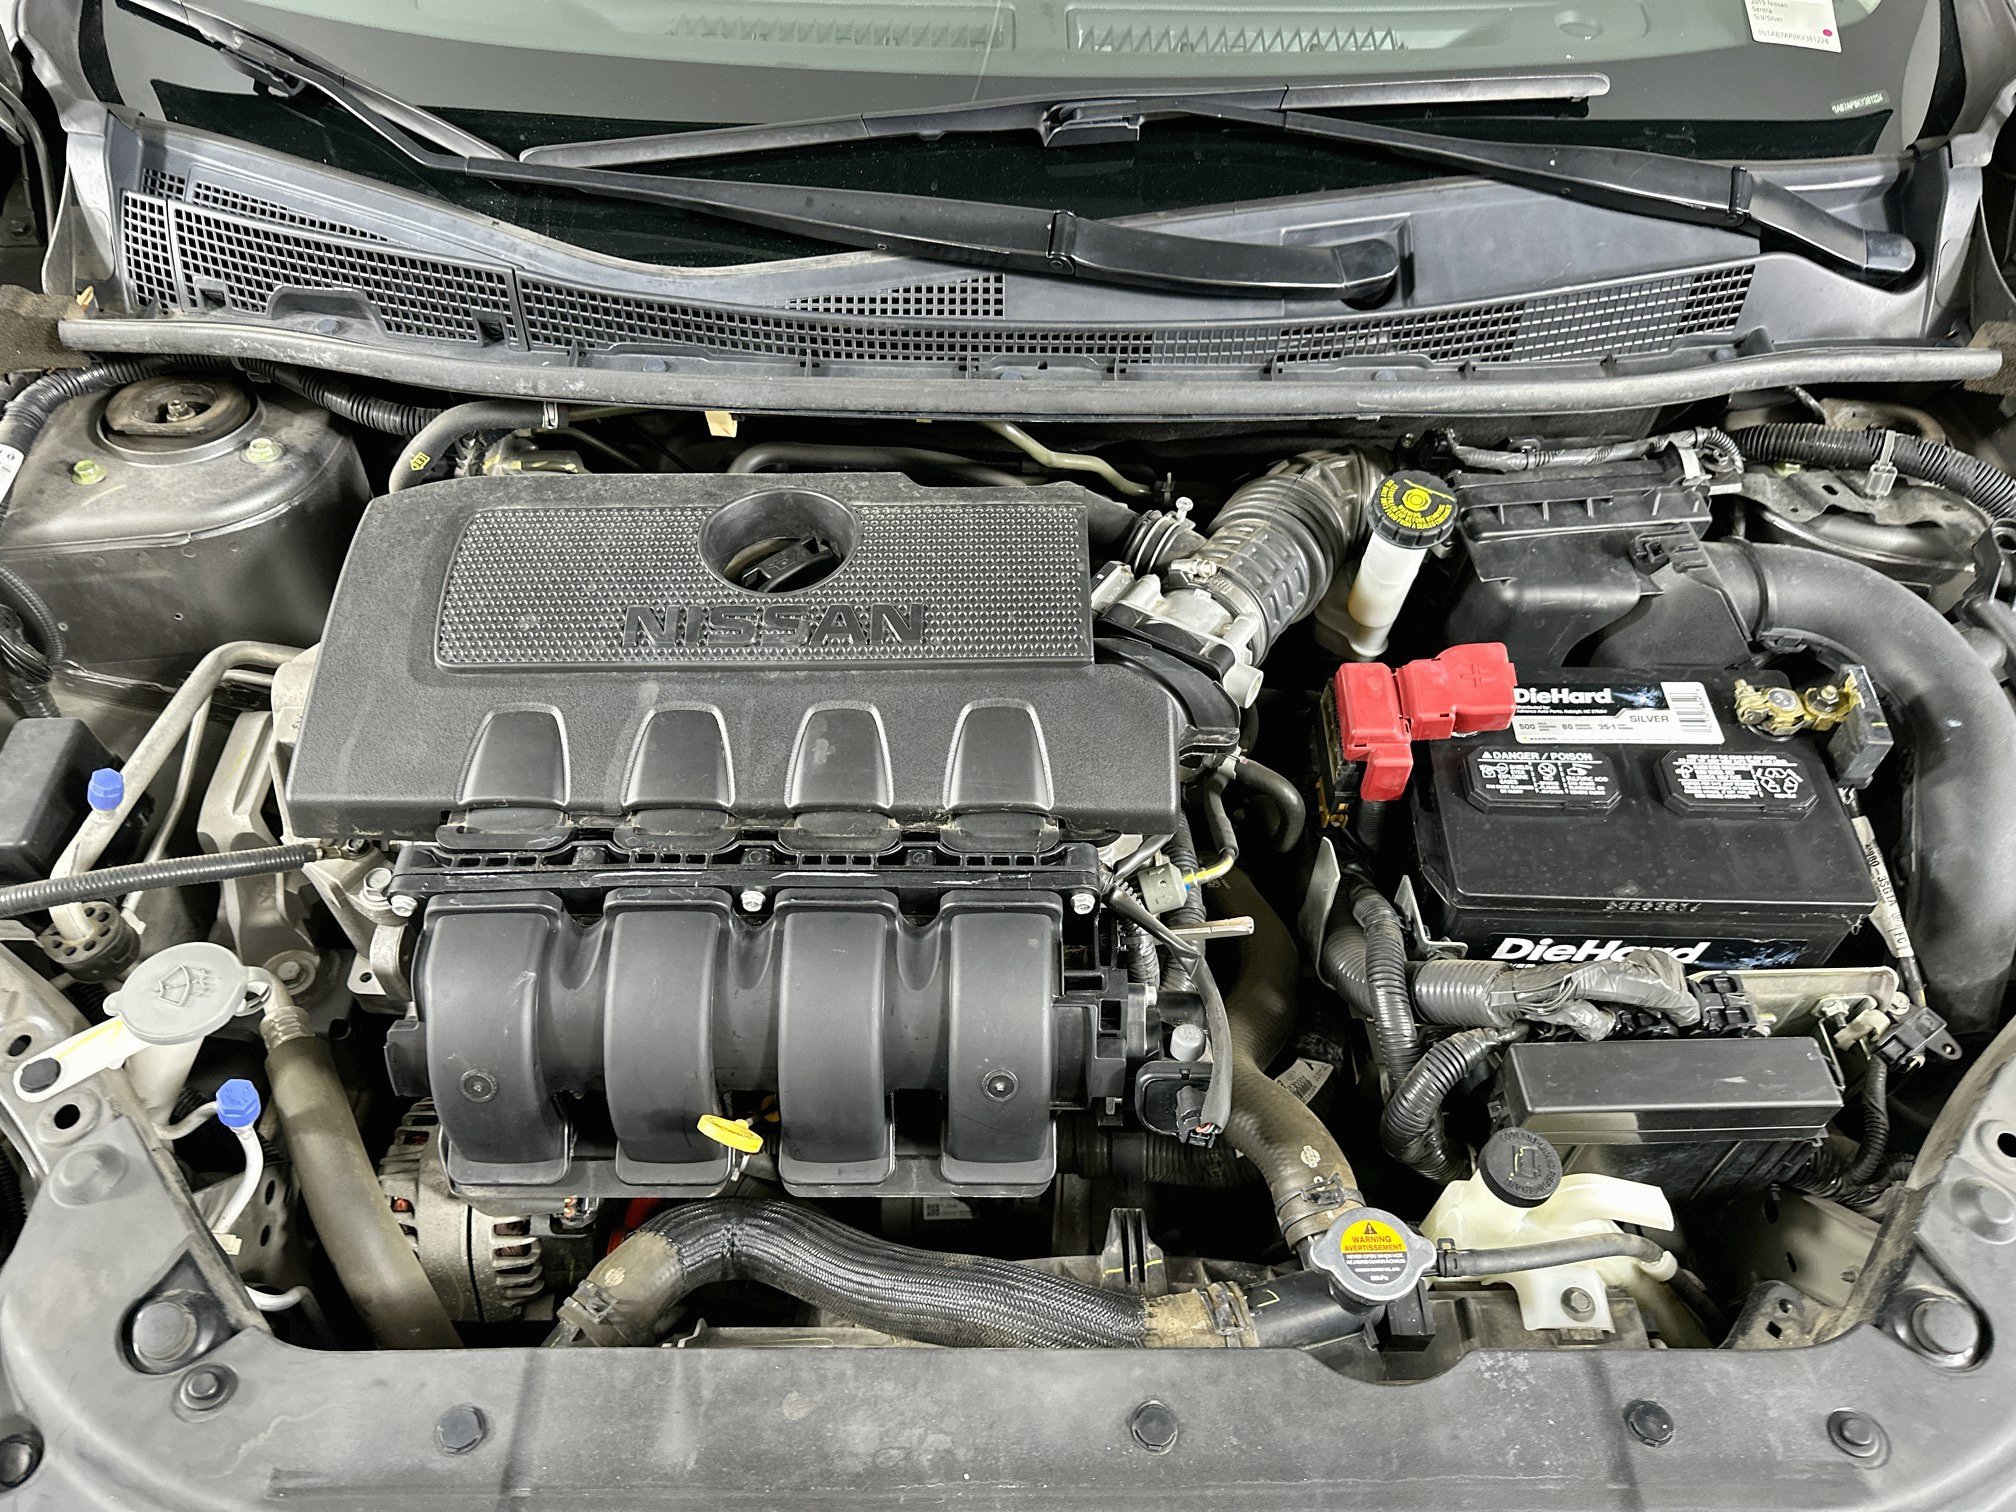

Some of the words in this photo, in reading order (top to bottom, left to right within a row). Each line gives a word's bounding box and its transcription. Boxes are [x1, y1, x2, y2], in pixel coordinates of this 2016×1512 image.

[1767, 0, 1788, 8] Nissan
[1754, 14, 1783, 23] SLV/Silver
[622, 604, 923, 647] NISSAN
[1512, 688, 1612, 704] DieHard
[1493, 751, 1539, 759] DANGER
